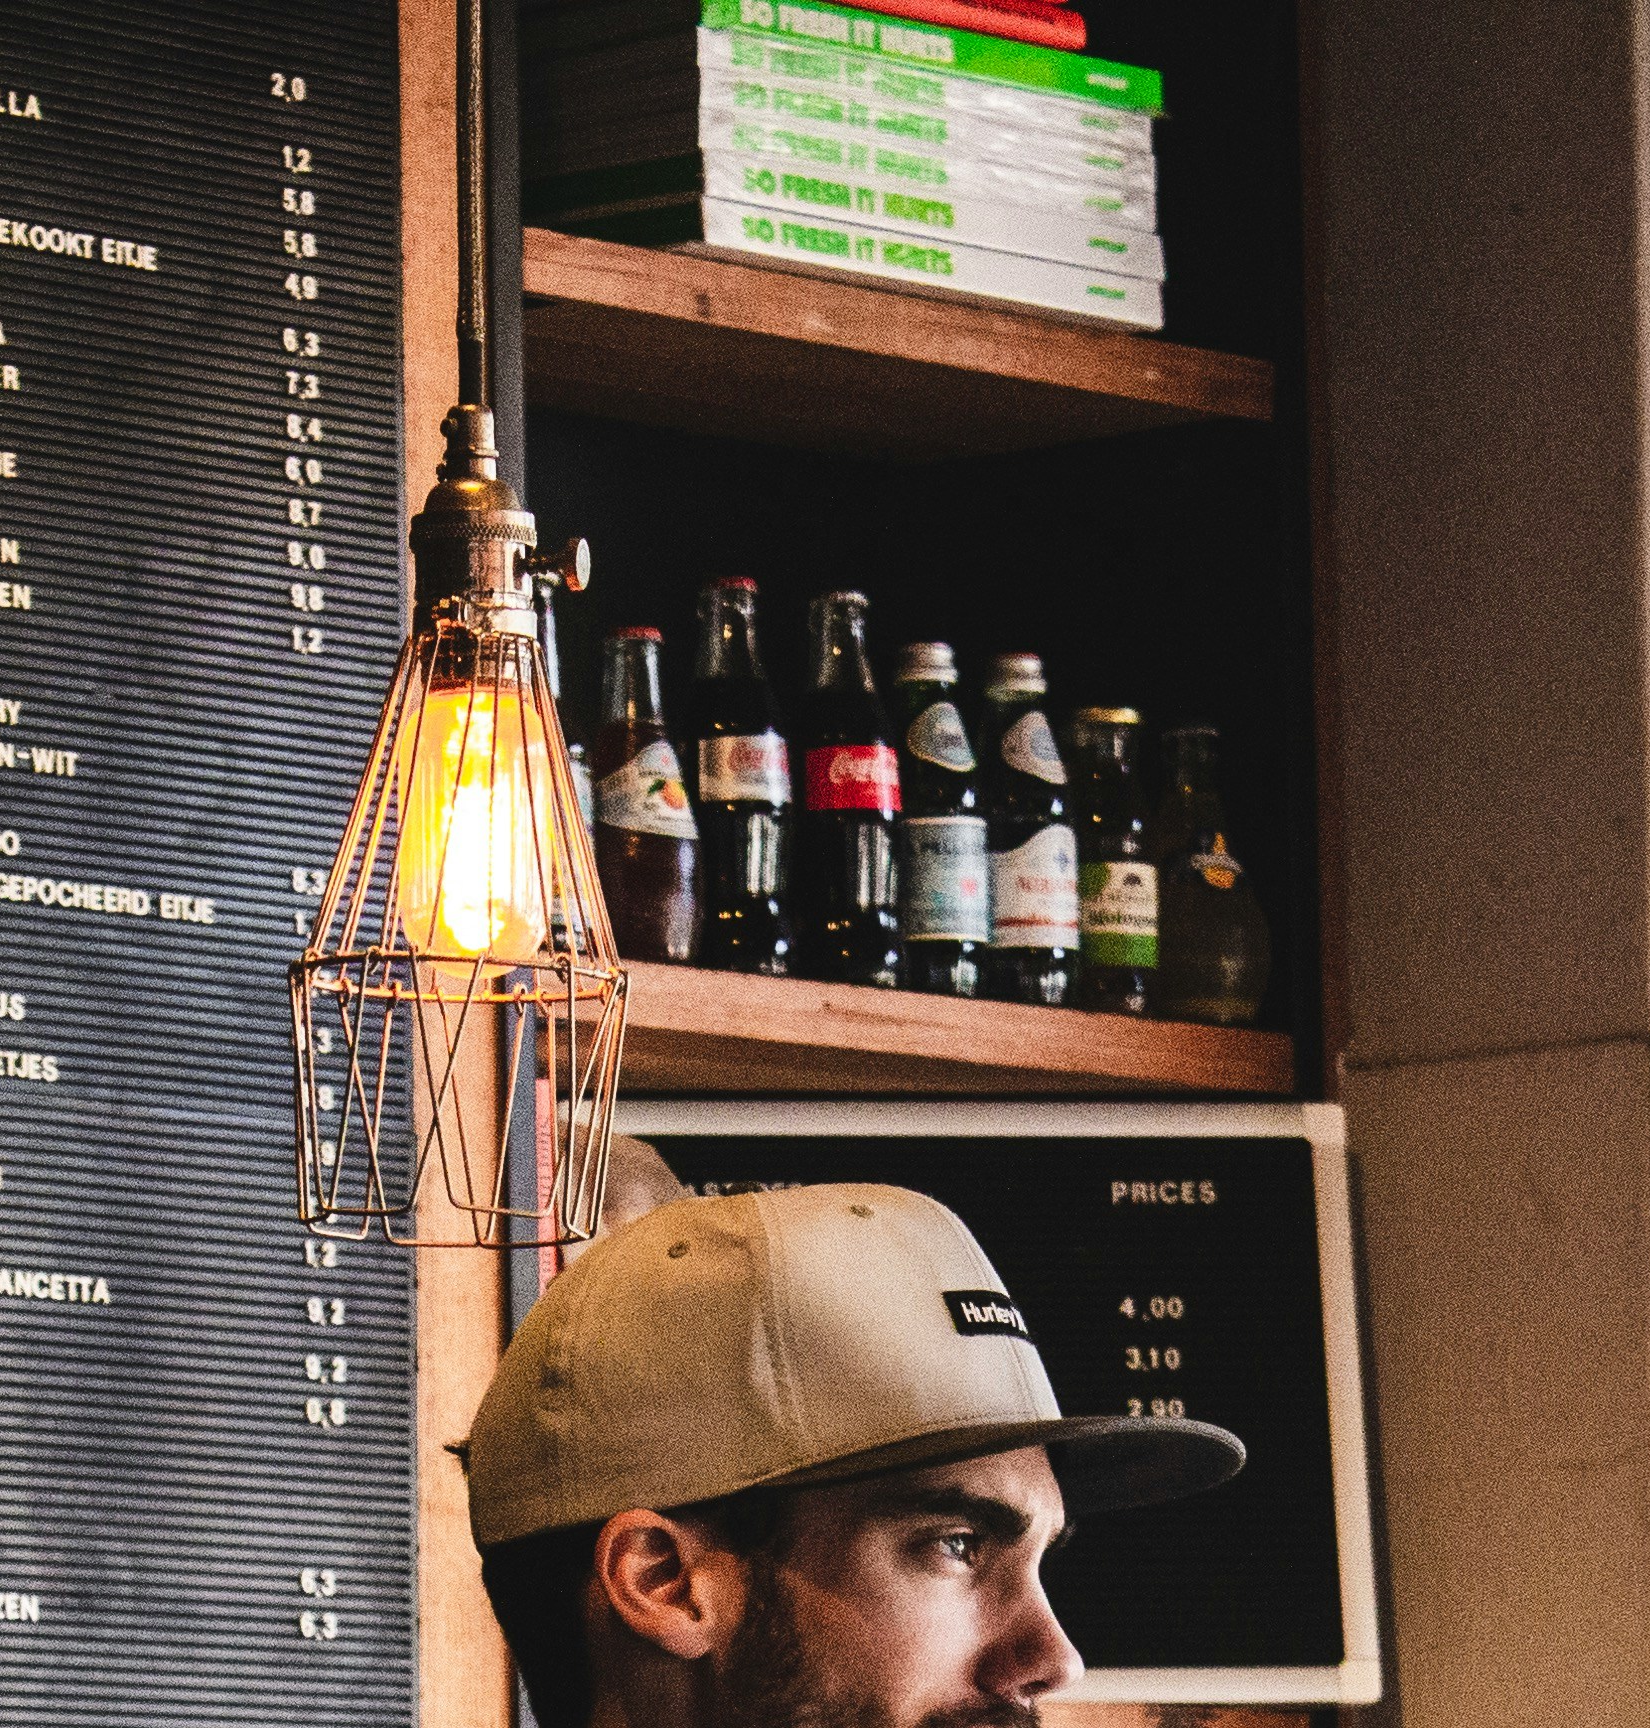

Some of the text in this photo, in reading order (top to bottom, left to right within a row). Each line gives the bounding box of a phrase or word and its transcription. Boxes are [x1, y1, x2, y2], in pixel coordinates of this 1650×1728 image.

[102, 238, 159, 271] EITJE
[159, 893, 215, 925] EITJE
[1111, 1180, 1218, 1206] PRICES
[960, 1301, 1017, 1328] Hurley
